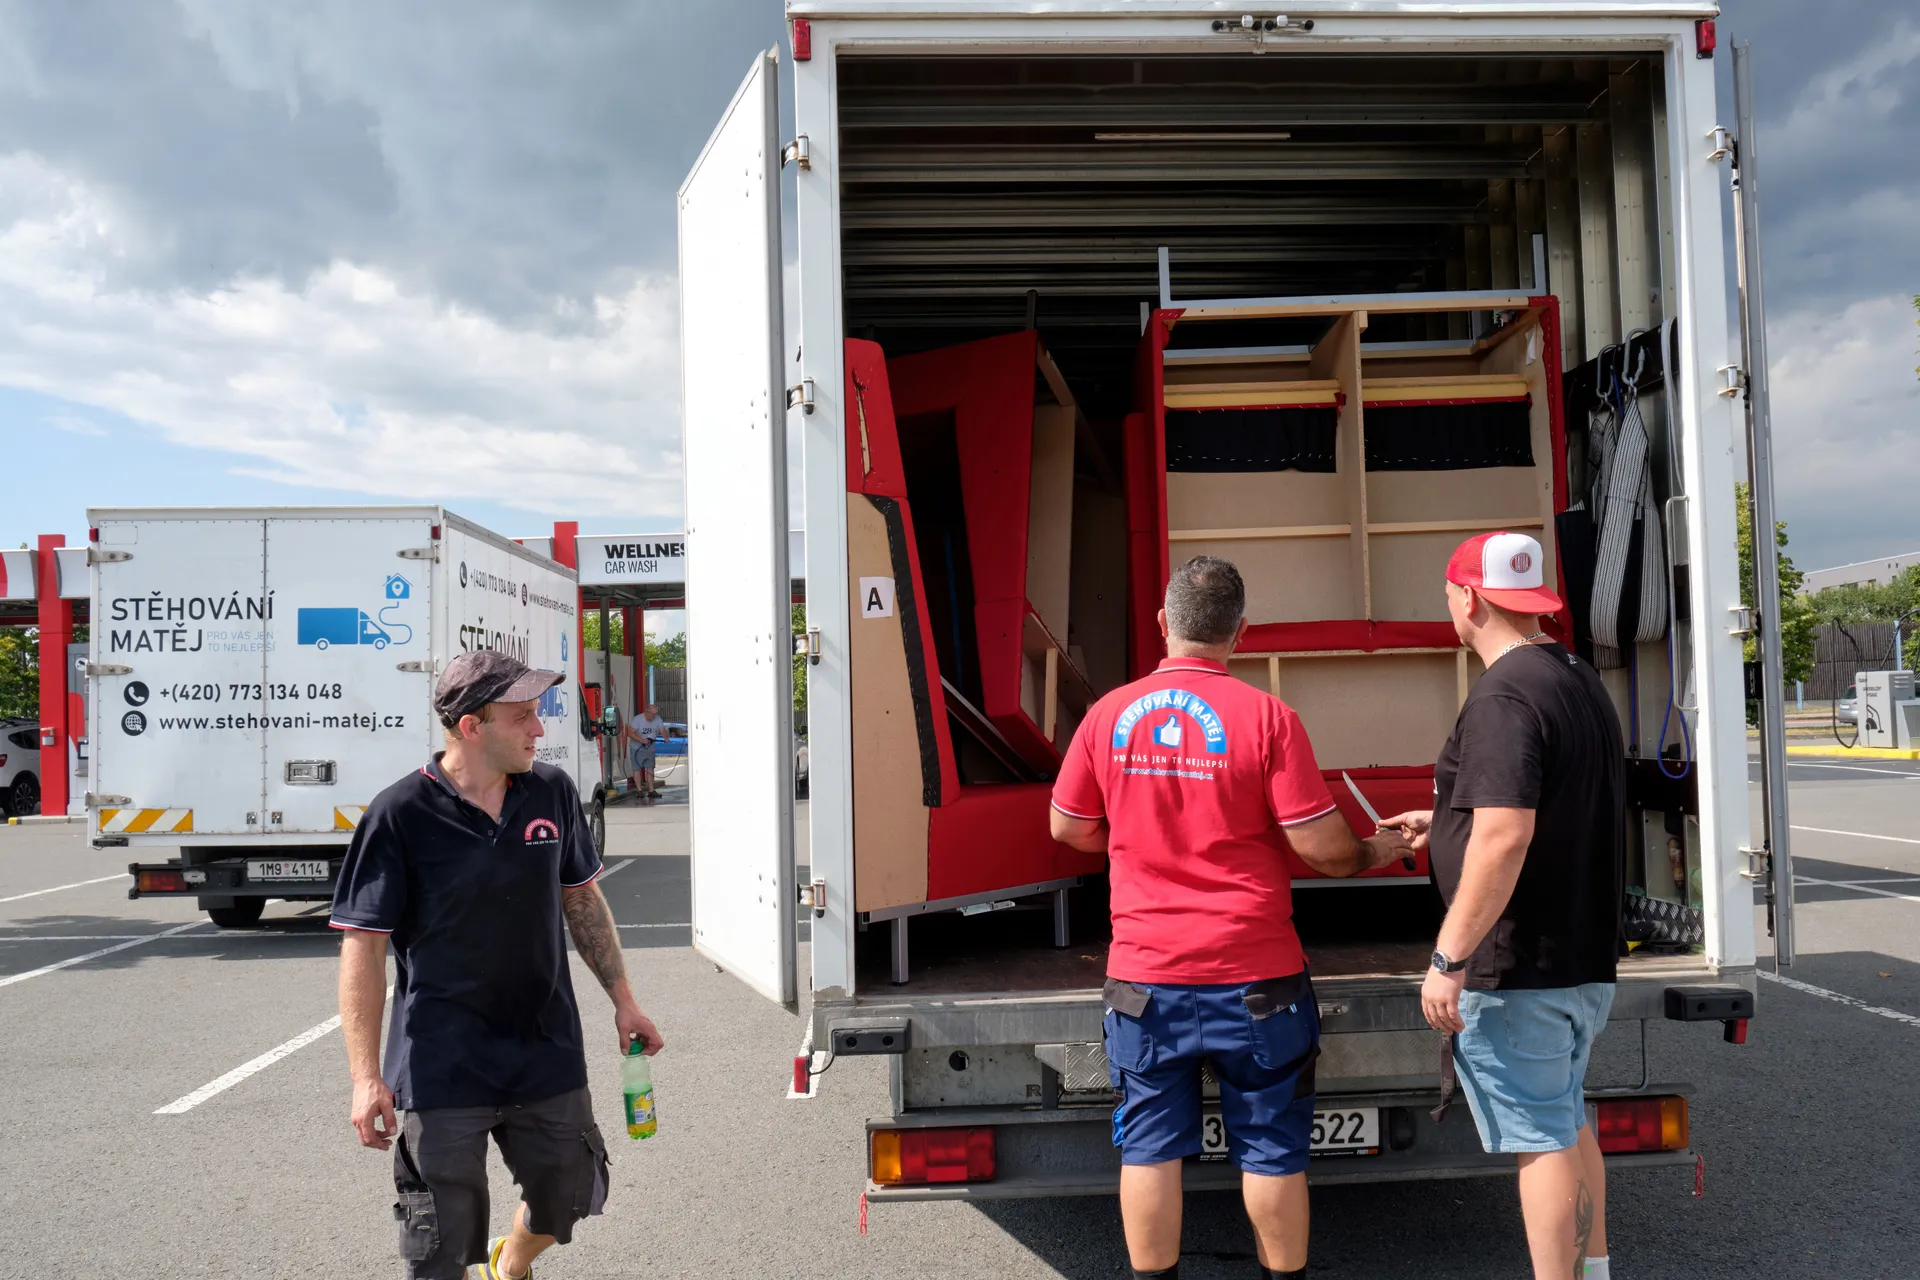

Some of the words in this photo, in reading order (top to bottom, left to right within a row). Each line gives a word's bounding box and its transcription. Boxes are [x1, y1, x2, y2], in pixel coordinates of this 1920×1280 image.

[605, 561, 626, 574] CAR
[627, 560, 658, 573] WASH
[111, 590, 276, 621] STĚHOVÁNÍ
[867, 587, 884, 611] A
[111, 622, 203, 653] MATĚJ
[206, 631, 228, 640] PRO
[208, 642, 220, 652] TO
[160, 683, 221, 702] +(420)
[229, 684, 262, 700] 773
[269, 684, 300, 700] 134
[307, 683, 343, 700] 048
[159, 712, 405, 732] www.stehovani-matej.cz
[1118, 690, 1191, 736] STĚHOVÁNÍ
[1190, 701, 1223, 743] MATĚJ
[1152, 755, 1167, 764] JEN
[1172, 756, 1182, 764] TO
[259, 863, 282, 876] 1M9
[291, 863, 322, 876] 4114
